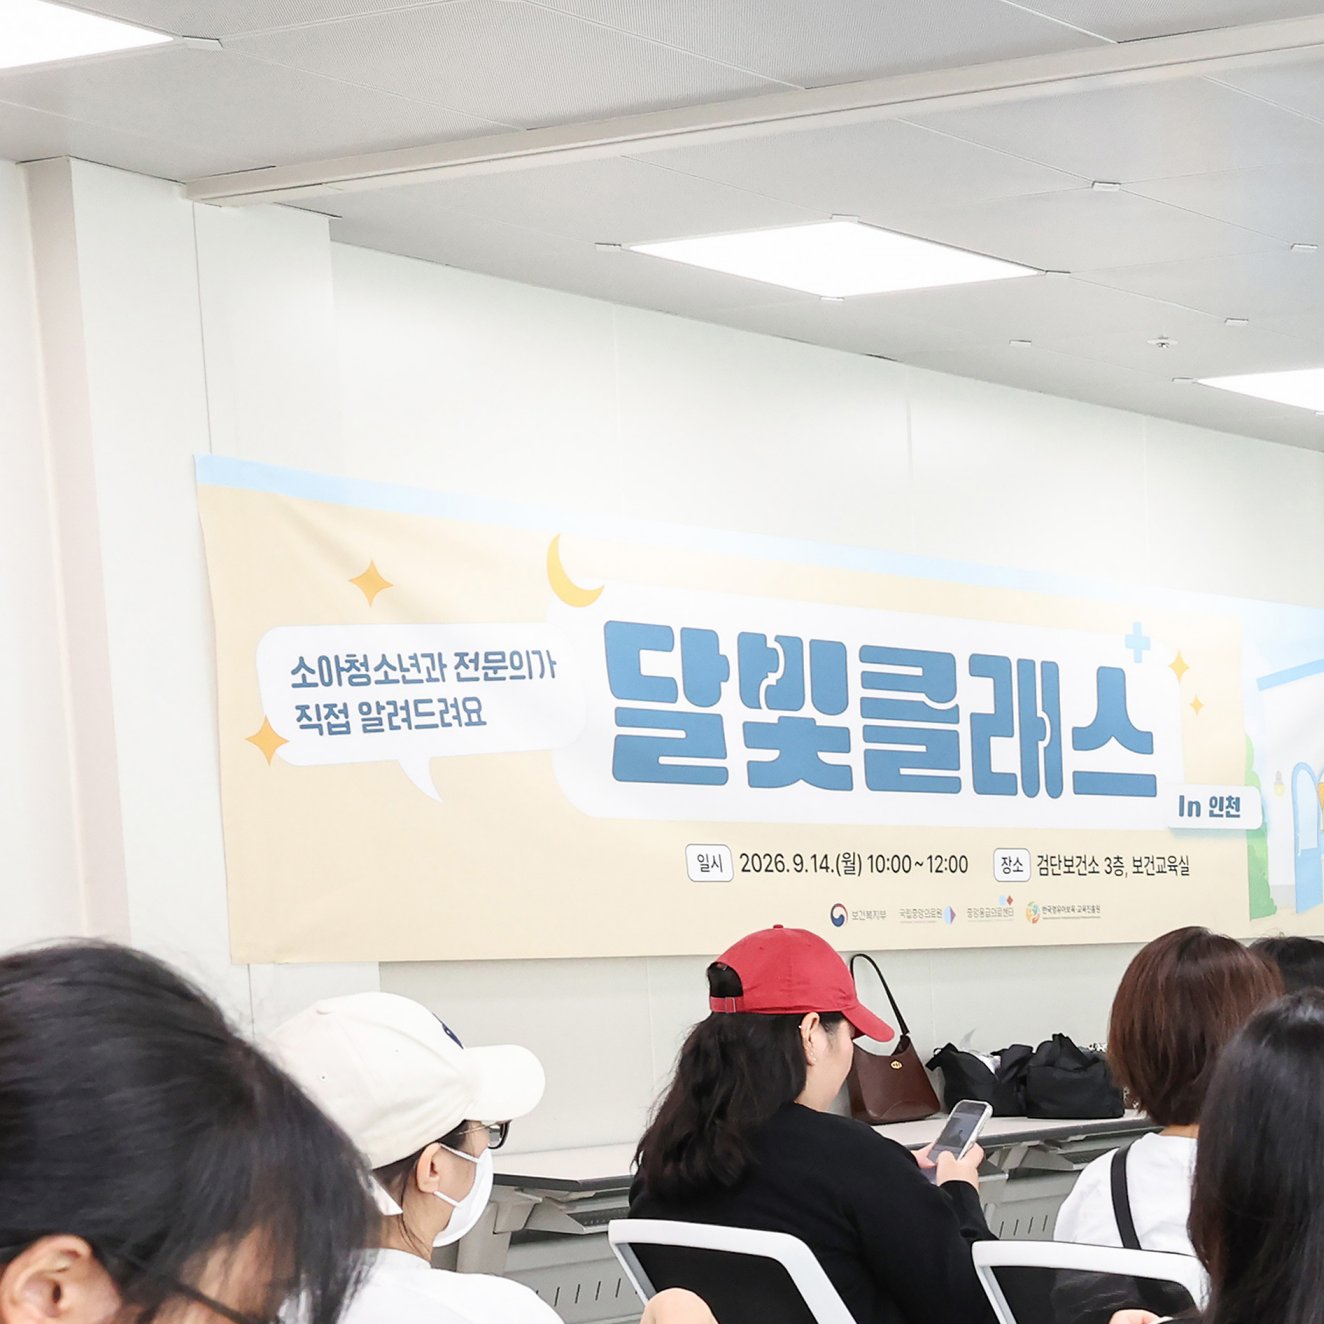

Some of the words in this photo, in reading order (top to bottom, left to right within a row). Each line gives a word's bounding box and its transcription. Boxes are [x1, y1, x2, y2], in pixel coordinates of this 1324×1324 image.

[290, 651, 447, 689] 소아청소년과
[453, 649, 557, 683] 전문의가
[294, 702, 352, 737] 직접
[357, 696, 487, 734] 알려드려요
[604, 620, 1158, 800] 달빛클래스
[1178, 794, 1202, 818] In
[1208, 795, 1241, 819] 인천
[697, 853, 723, 873] 일시
[1001, 856, 1024, 875] 장소
[1036, 854, 1100, 877] 검단보건소
[1104, 855, 1128, 878] 3층,
[1132, 855, 1190, 877] 보건교육실
